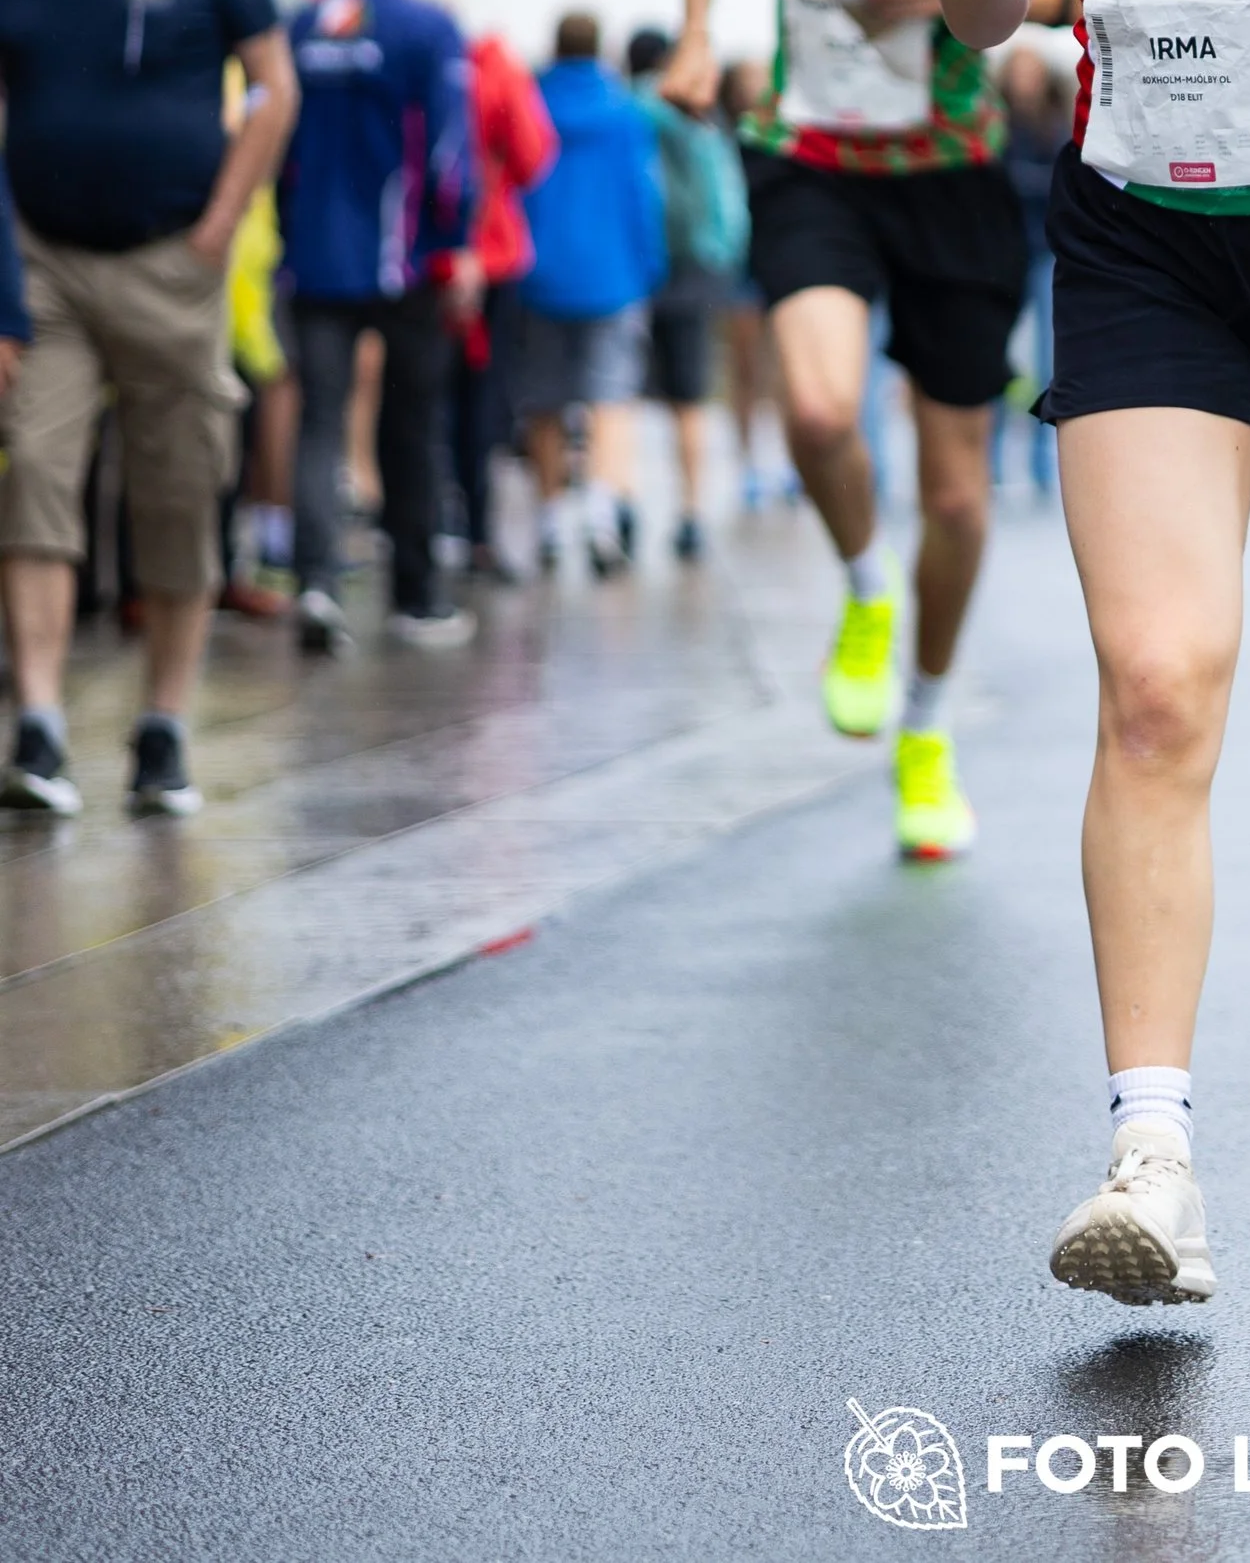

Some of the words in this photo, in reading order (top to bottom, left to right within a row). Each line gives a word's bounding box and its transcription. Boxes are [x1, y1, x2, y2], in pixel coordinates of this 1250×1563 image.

[1149, 36, 1217, 60] IRMA
[1219, 75, 1231, 84] OL
[1170, 93, 1186, 102] D18
[1187, 93, 1204, 102] ELIT
